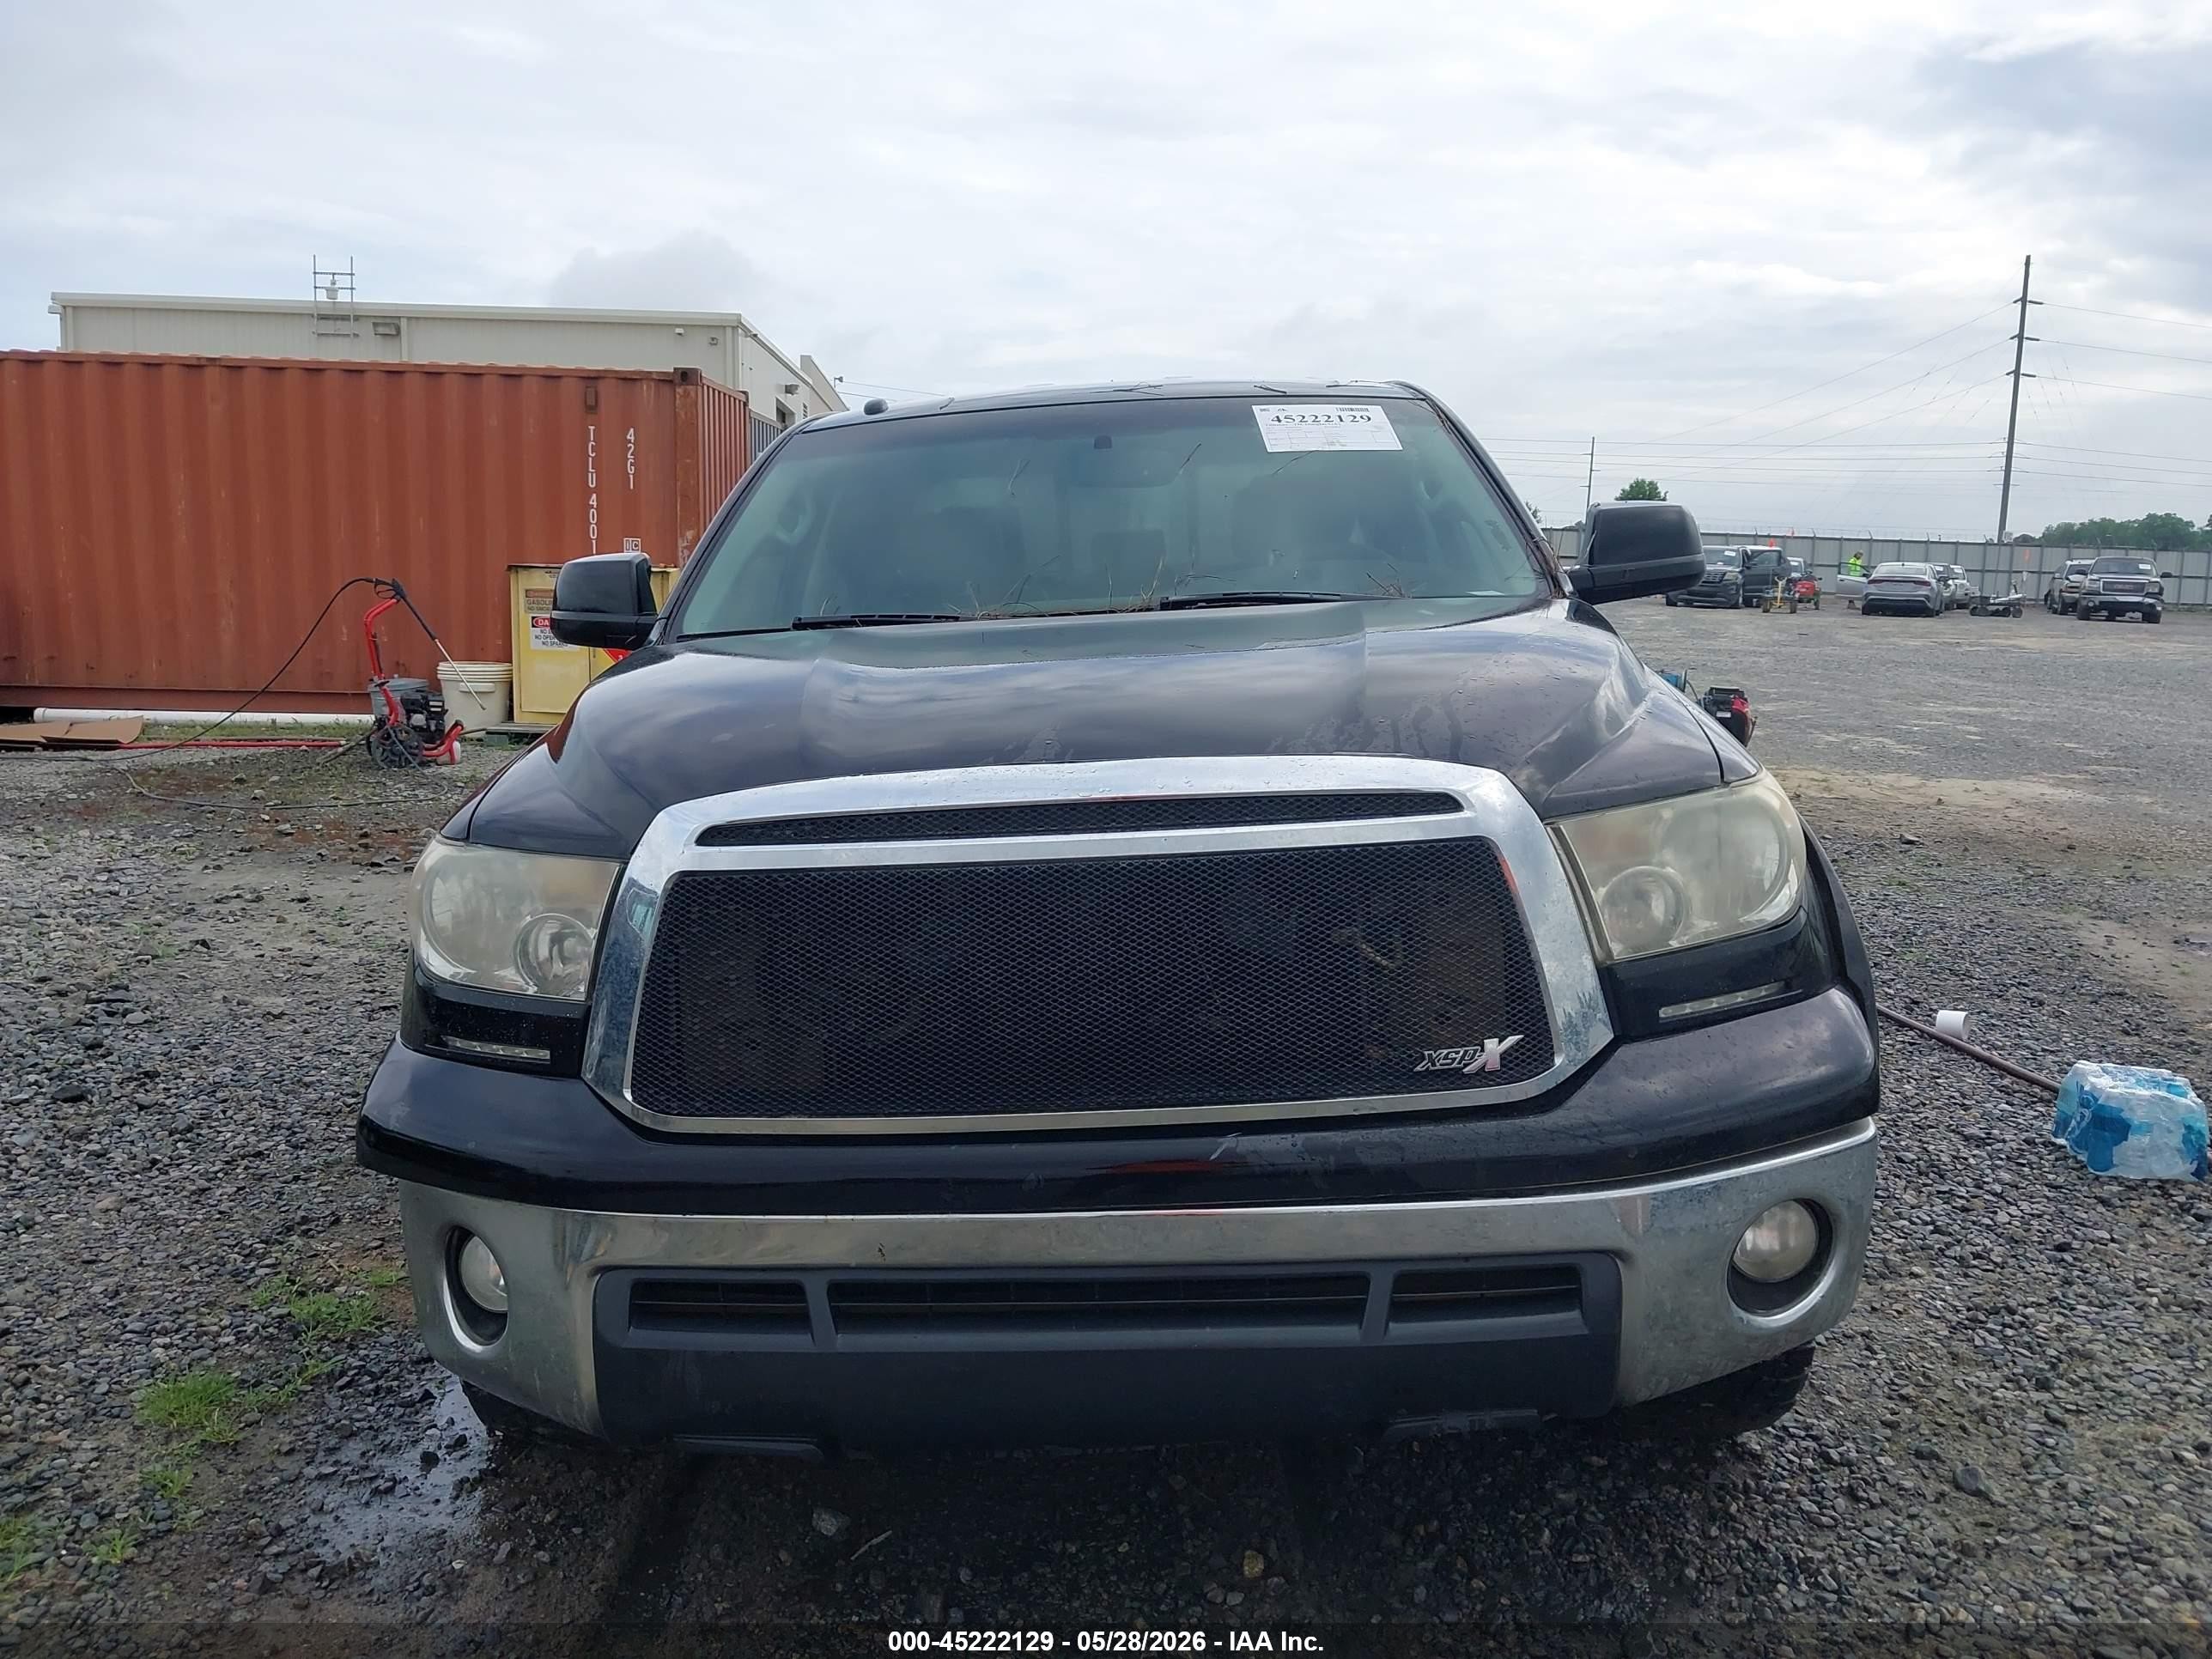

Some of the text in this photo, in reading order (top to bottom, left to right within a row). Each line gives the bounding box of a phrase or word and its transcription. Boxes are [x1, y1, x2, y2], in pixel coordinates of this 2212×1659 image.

[1271, 414, 1372, 423] 45222129
[587, 425, 597, 488] TCLU
[626, 428, 635, 489] 42G1
